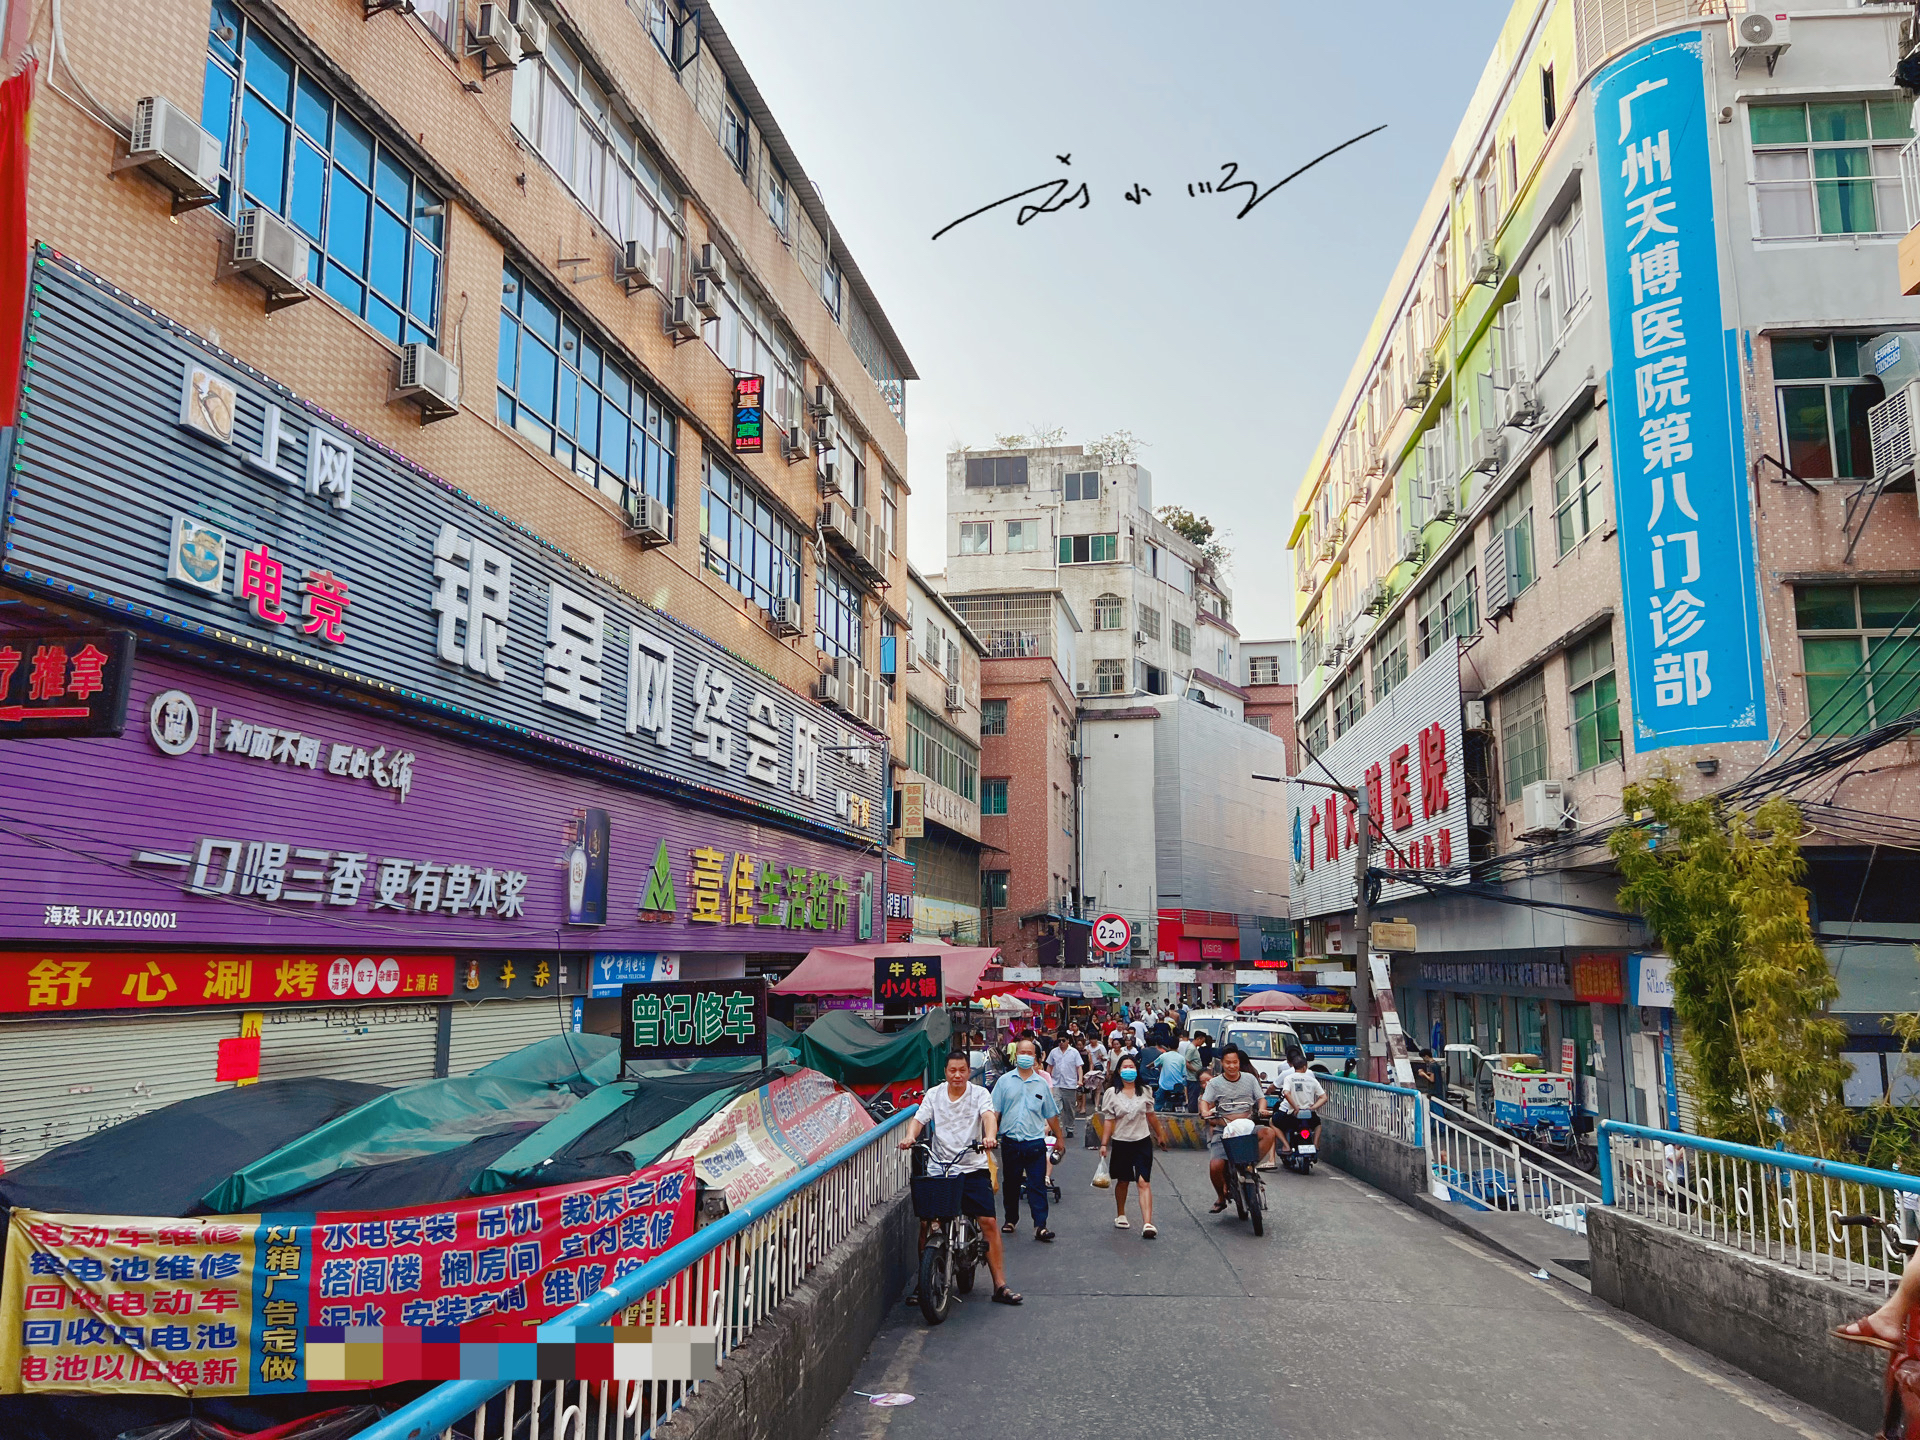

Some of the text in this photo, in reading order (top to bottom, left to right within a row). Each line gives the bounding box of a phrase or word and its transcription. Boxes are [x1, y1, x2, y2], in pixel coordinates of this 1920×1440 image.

[737, 380, 760, 437] 银星公寓
[1617, 77, 1713, 707] 广州天博医院第八门诊部
[240, 402, 355, 510] 上网
[234, 544, 351, 645] 电竞
[431, 521, 821, 801] 银星网络会所
[225, 719, 322, 769] 和而不同
[905, 785, 922, 827] 银星公寓
[131, 838, 528, 918] 一口喝三香 更有草本浆
[690, 845, 850, 931] 壹佳生活超市
[27, 957, 319, 1006] 舒心涮烤
[357, 970, 374, 983] 饺子
[403, 973, 439, 992] 上涌店
[500, 959, 551, 989] 牛杂
[616, 956, 646, 973] 中国电信
[880, 977, 937, 999] 小火锅
[889, 962, 927, 977] 牛杂
[632, 991, 756, 1047] 曾记修车
[27, 1222, 245, 1249] 电动车维修
[322, 1171, 687, 1253] 水电安装 吊机 裁床定做
[320, 1255, 424, 1300] 搭阁楼
[552, 1211, 675, 1263] 室内装修
[23, 1284, 240, 1317] 回收电动车
[260, 1224, 302, 1382] 灯箱广告定做
[543, 1265, 606, 1308] 维修
